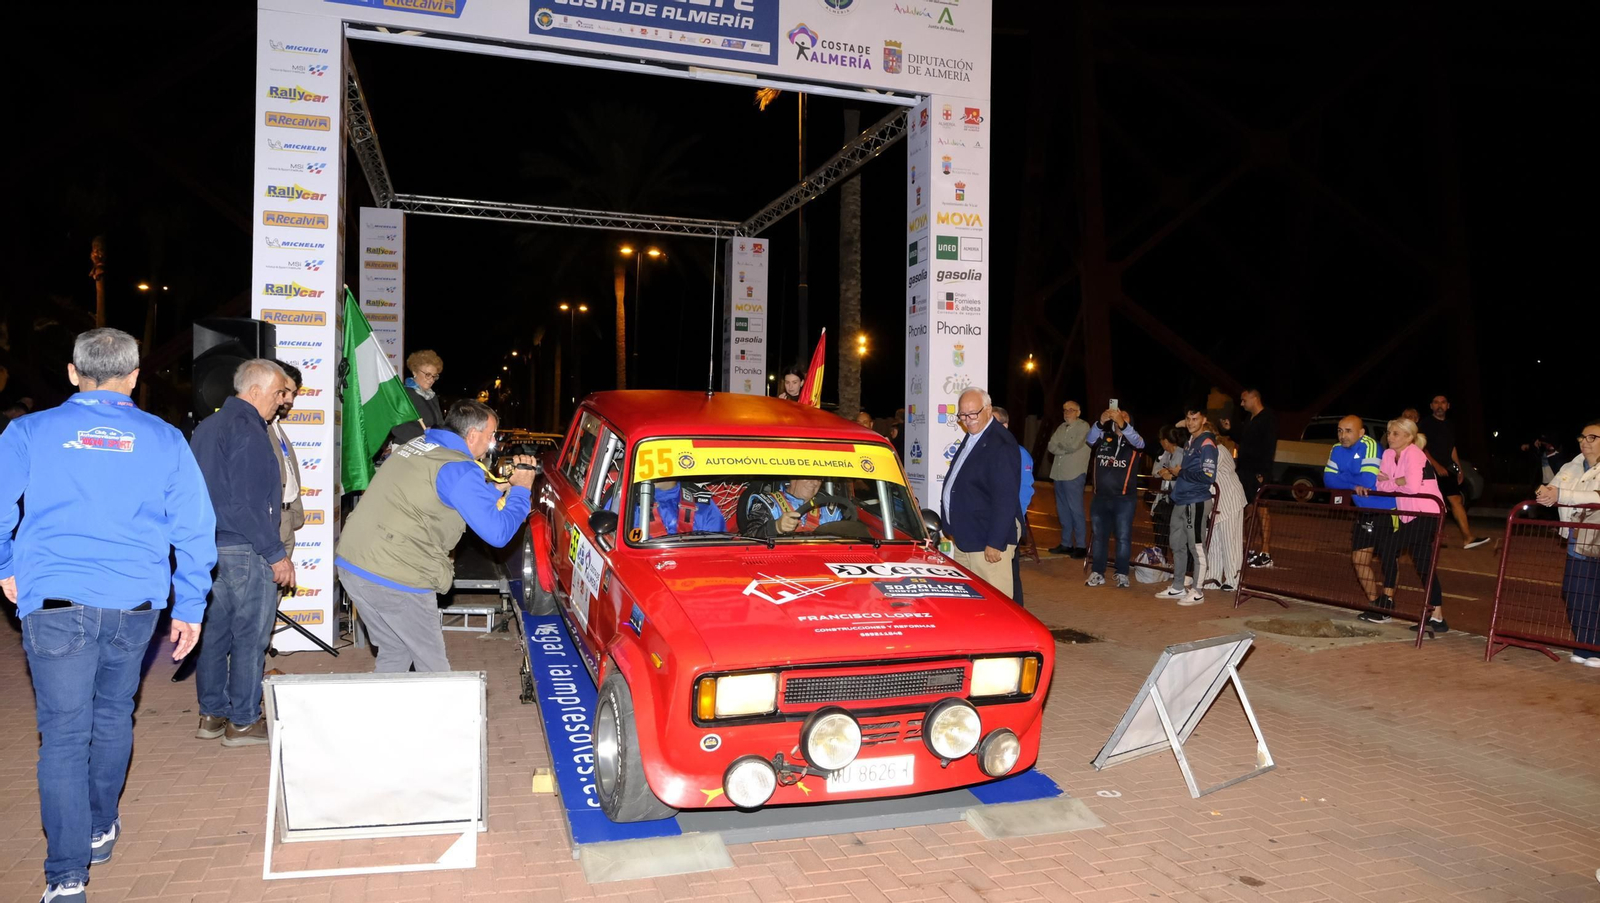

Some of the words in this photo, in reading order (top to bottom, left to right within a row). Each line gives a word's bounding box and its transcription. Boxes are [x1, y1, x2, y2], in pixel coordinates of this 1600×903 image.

[629, 2, 658, 16] DE
[662, 6, 754, 30] ALMERÍA
[285, 44, 328, 54] MICHELIN
[821, 40, 855, 53] COSTA
[858, 45, 871, 55] DE
[810, 51, 872, 70] ALMERÍA
[908, 53, 973, 71] DIPUTACIÓN
[908, 65, 922, 75] DE
[925, 68, 970, 82] ALMERÍA
[270, 86, 328, 103] Rallycar
[278, 115, 318, 127] Recalvi
[283, 143, 327, 152] MICHELIN
[267, 185, 327, 201] Rallycar
[276, 214, 316, 226] Recalvi
[937, 212, 983, 227] MOYA
[909, 269, 927, 288] gasolia
[937, 269, 982, 282] gasolia
[266, 284, 324, 298] Rallycar
[274, 312, 313, 322] Recalvi
[909, 324, 927, 337] Phonika
[937, 321, 981, 336] Phonika
[735, 336, 762, 344] gasolia
[735, 366, 762, 375] Phonika
[286, 412, 311, 422] calvi
[638, 448, 673, 479] 55
[705, 456, 768, 465] AUTOMÓVIL
[812, 459, 854, 468] ALMERÍA
[633, 530, 641, 539] H
[798, 613, 880, 621] FRANCISCO
[832, 767, 851, 784] MU
[859, 763, 896, 782] 8626
